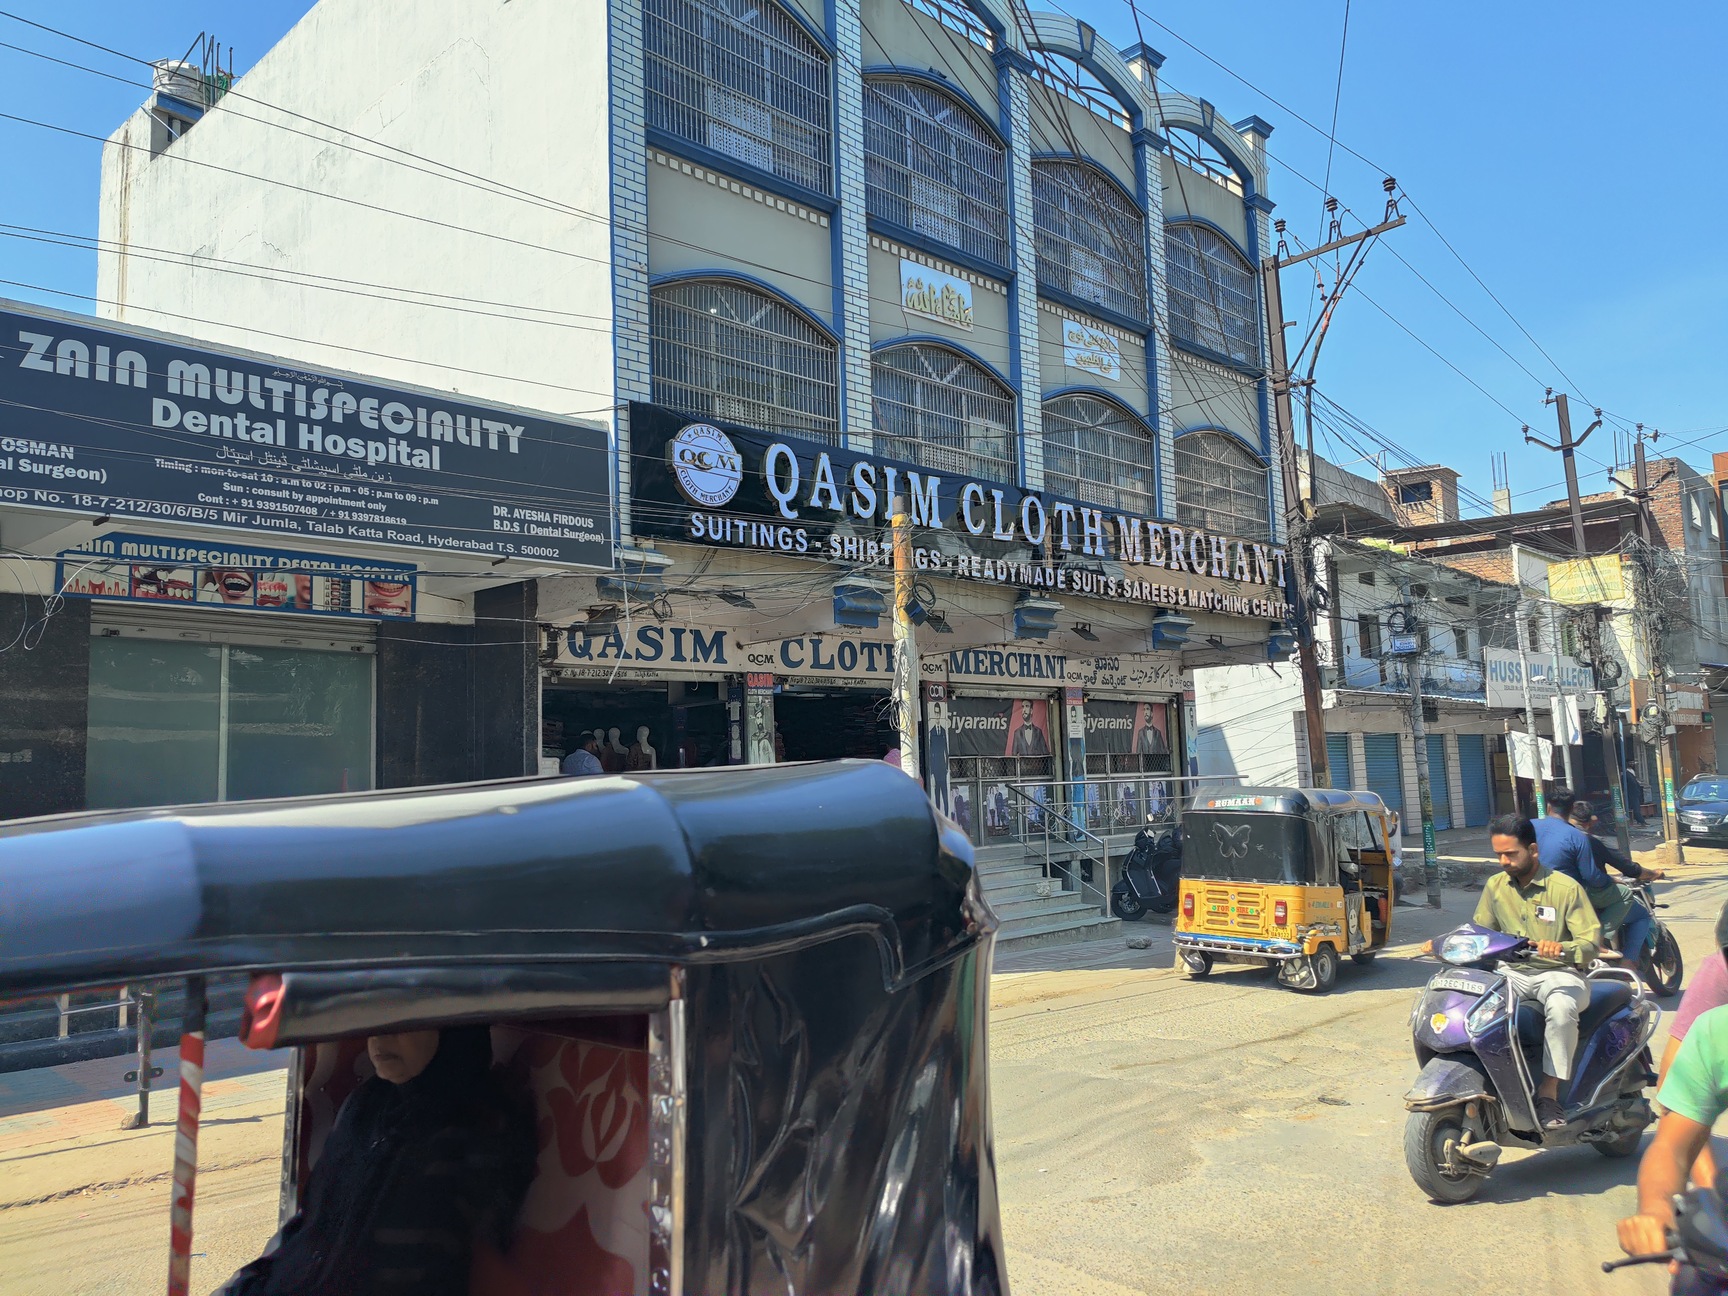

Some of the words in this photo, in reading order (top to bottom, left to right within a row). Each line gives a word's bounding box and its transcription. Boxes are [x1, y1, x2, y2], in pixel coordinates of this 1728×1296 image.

[19, 331, 147, 389] ZAIN
[167, 360, 524, 453] MULTISPECIALITY
[152, 398, 285, 447] Dental
[299, 423, 440, 471] Hospital
[1, 438, 75, 460] OSMAN
[679, 448, 737, 473] QCM
[18, 458, 107, 484] Surgeon)
[155, 458, 192, 474] Timing
[201, 466, 258, 481] mon-to-sat
[261, 473, 273, 483] 10
[302, 479, 312, 489] to
[314, 480, 326, 490] 02
[334, 484, 351, 494] p.m
[358, 487, 370, 497] 05
[377, 490, 393, 500] p.m
[394, 491, 403, 500] to
[405, 493, 417, 503] 09
[423, 496, 439, 506] p.m
[198, 492, 223, 505] Cont
[241, 498, 254, 508] 91
[257, 500, 318, 516] 9391507408
[223, 482, 244, 493] Sun
[252, 486, 290, 499] consult
[292, 490, 304, 502] by
[306, 493, 366, 508] appointment
[368, 501, 387, 513] only
[0, 488, 28, 501] op
[34, 489, 65, 504] No.
[72, 494, 218, 520] 18-7-212/30/6/B/5
[223, 511, 248, 524] Mir
[252, 514, 301, 531] Jumla,
[306, 520, 344, 535] Talab
[348, 525, 383, 539] Katta
[387, 530, 424, 545] Road,
[428, 534, 494, 552] Hyderabad
[497, 542, 518, 554] T.S.
[521, 545, 559, 558] 500002
[493, 505, 511, 518] DR.
[513, 508, 551, 523] AYESHA
[553, 513, 594, 529] FIRDOUS
[764, 442, 943, 529] QASIM
[961, 482, 1106, 558] CLOTH
[1119, 514, 1288, 588] MERCHANT
[493, 519, 520, 533] B.D.S
[530, 523, 561, 538] Dental
[563, 528, 605, 545] Surgeon)
[690, 511, 808, 553] SUITINGS
[830, 533, 941, 570] SHIRTGS
[958, 554, 1066, 589] READYMADE
[567, 620, 728, 665] QASIM
[747, 653, 775, 666] QCM
[949, 649, 1066, 680] MERCHANT
[1489, 659, 1544, 685] HUSSINI
[1083, 713, 1133, 733] iyaram's
